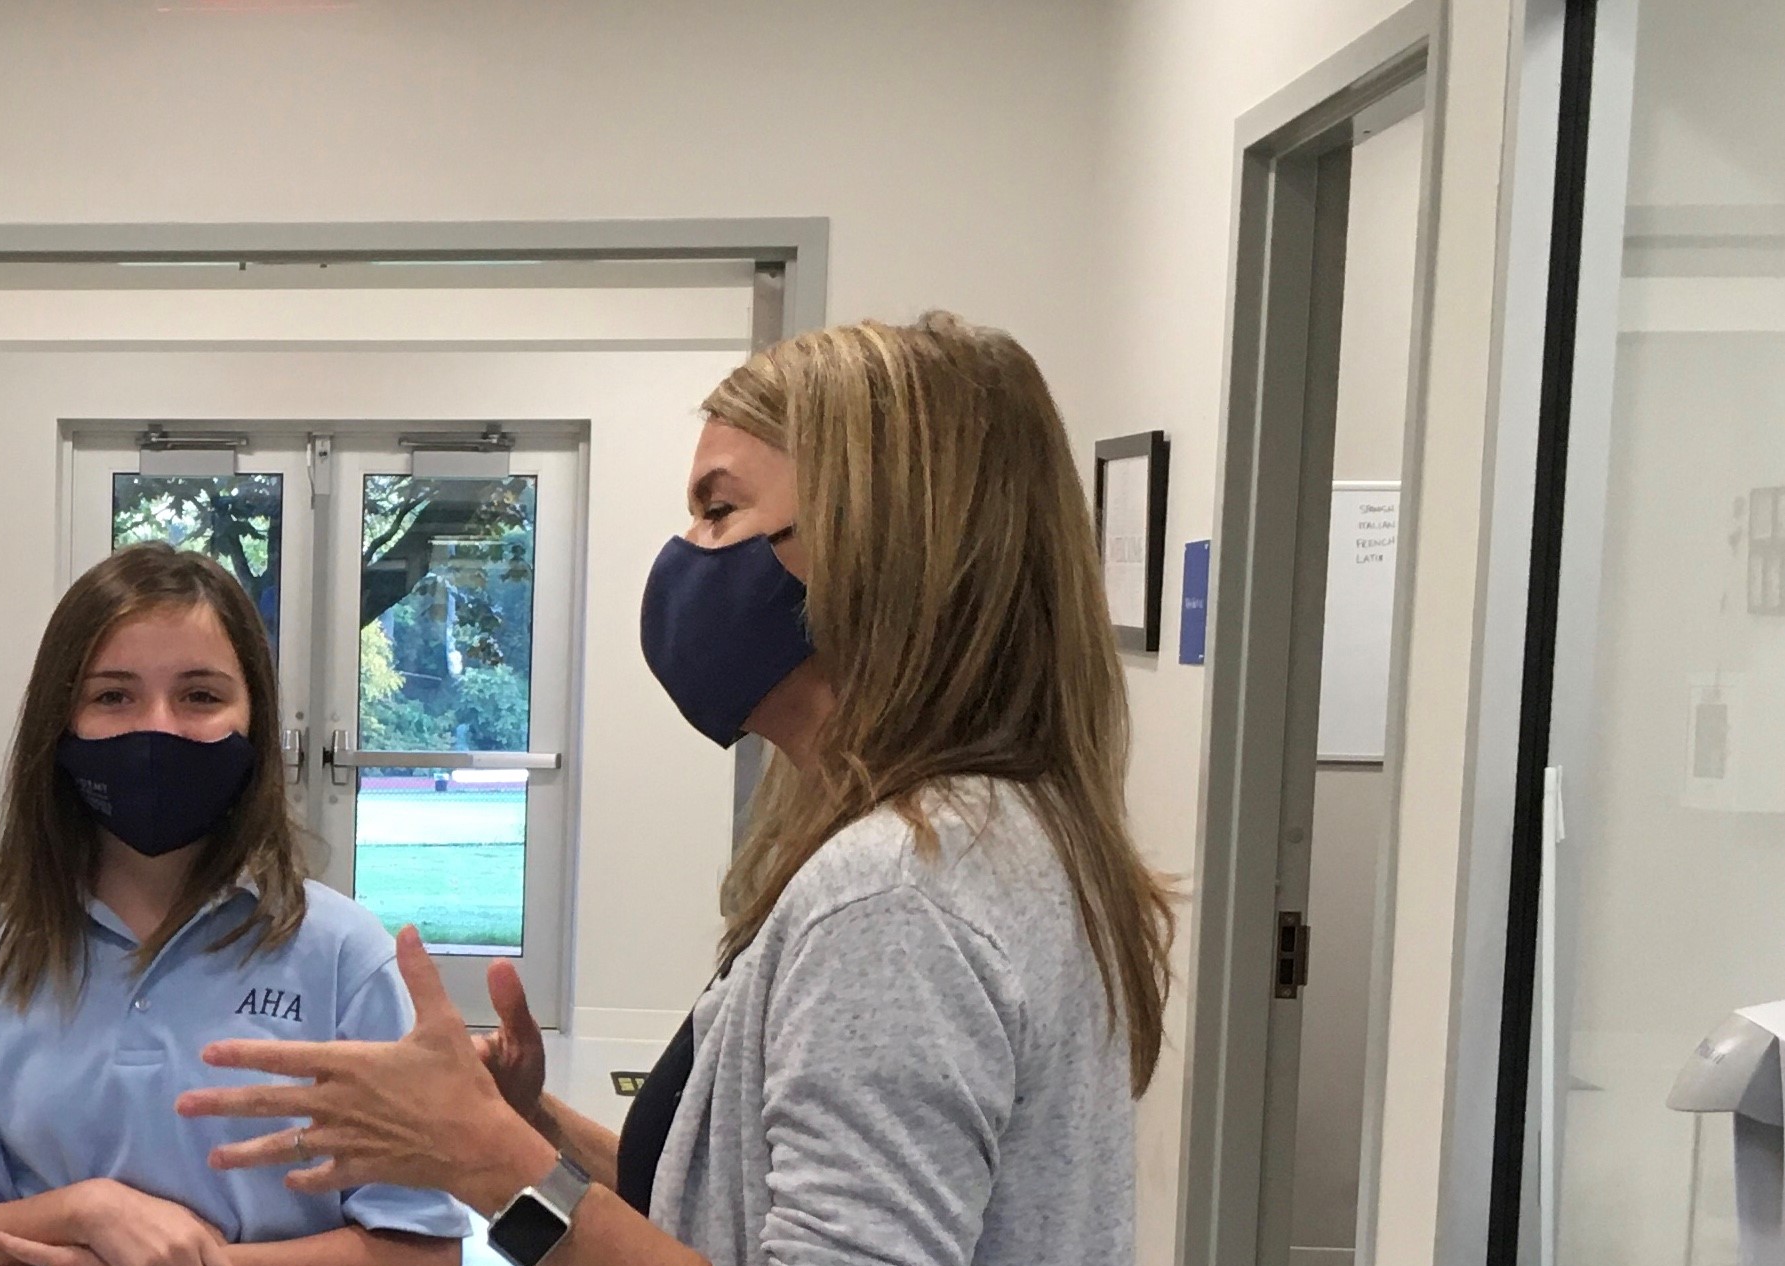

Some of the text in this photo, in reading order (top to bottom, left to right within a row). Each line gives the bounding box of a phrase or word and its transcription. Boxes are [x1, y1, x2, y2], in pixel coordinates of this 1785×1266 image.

[1358, 521, 1395, 530] ITALIAN
[1356, 536, 1395, 548] FRENCH
[234, 987, 303, 1022] AHA
